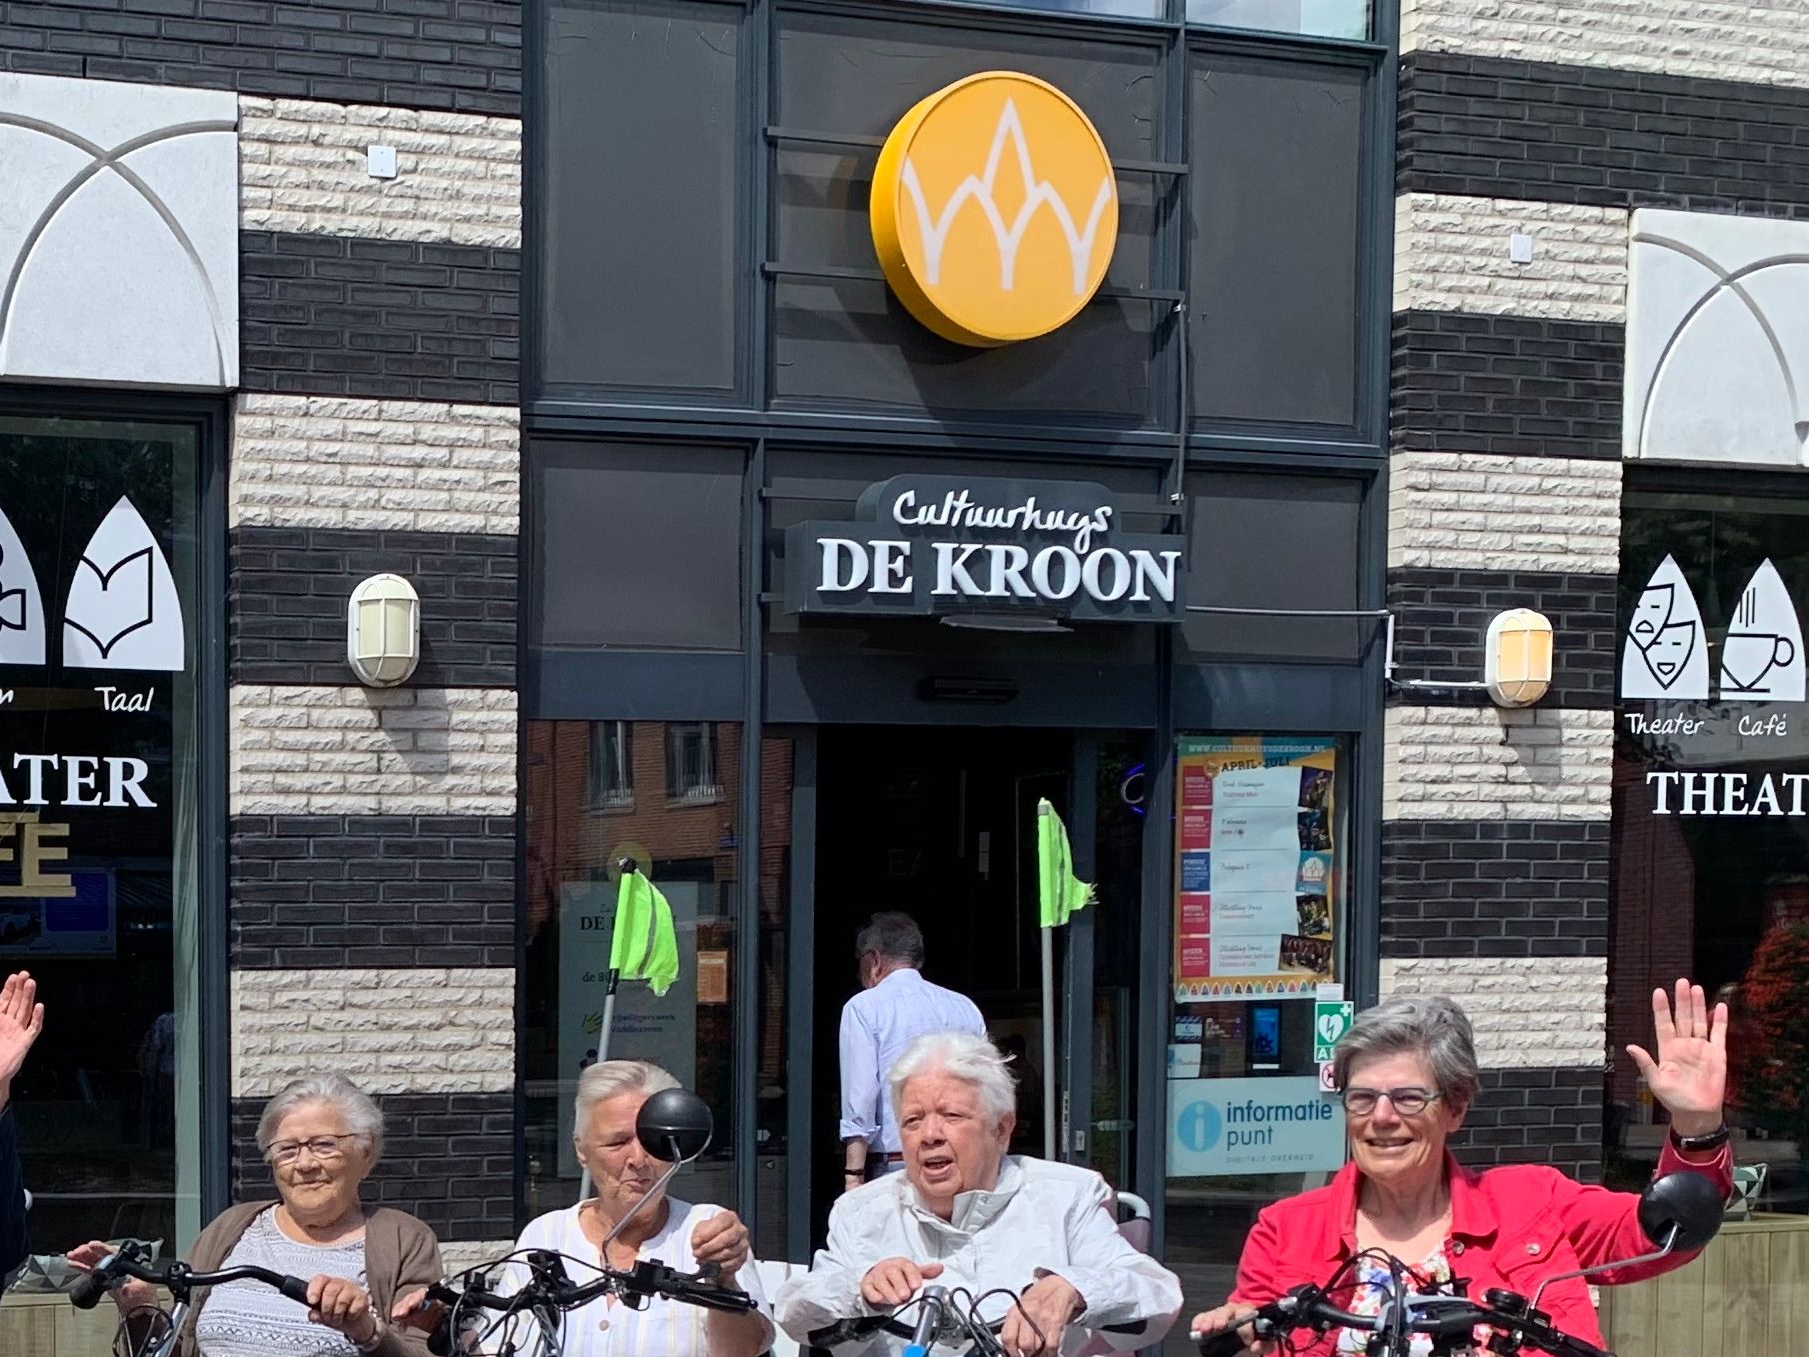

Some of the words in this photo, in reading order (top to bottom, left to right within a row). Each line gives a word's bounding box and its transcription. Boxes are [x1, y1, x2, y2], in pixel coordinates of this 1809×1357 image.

[893, 489, 1113, 554] Cultuurhuys
[817, 537, 913, 593] DE
[931, 541, 1182, 602] KROON
[94, 686, 155, 712] Taal
[1624, 712, 1705, 735] Theater
[1738, 713, 1787, 737] Café
[1227, 1099, 1333, 1123] informatie
[1227, 1126, 1273, 1152] punt
